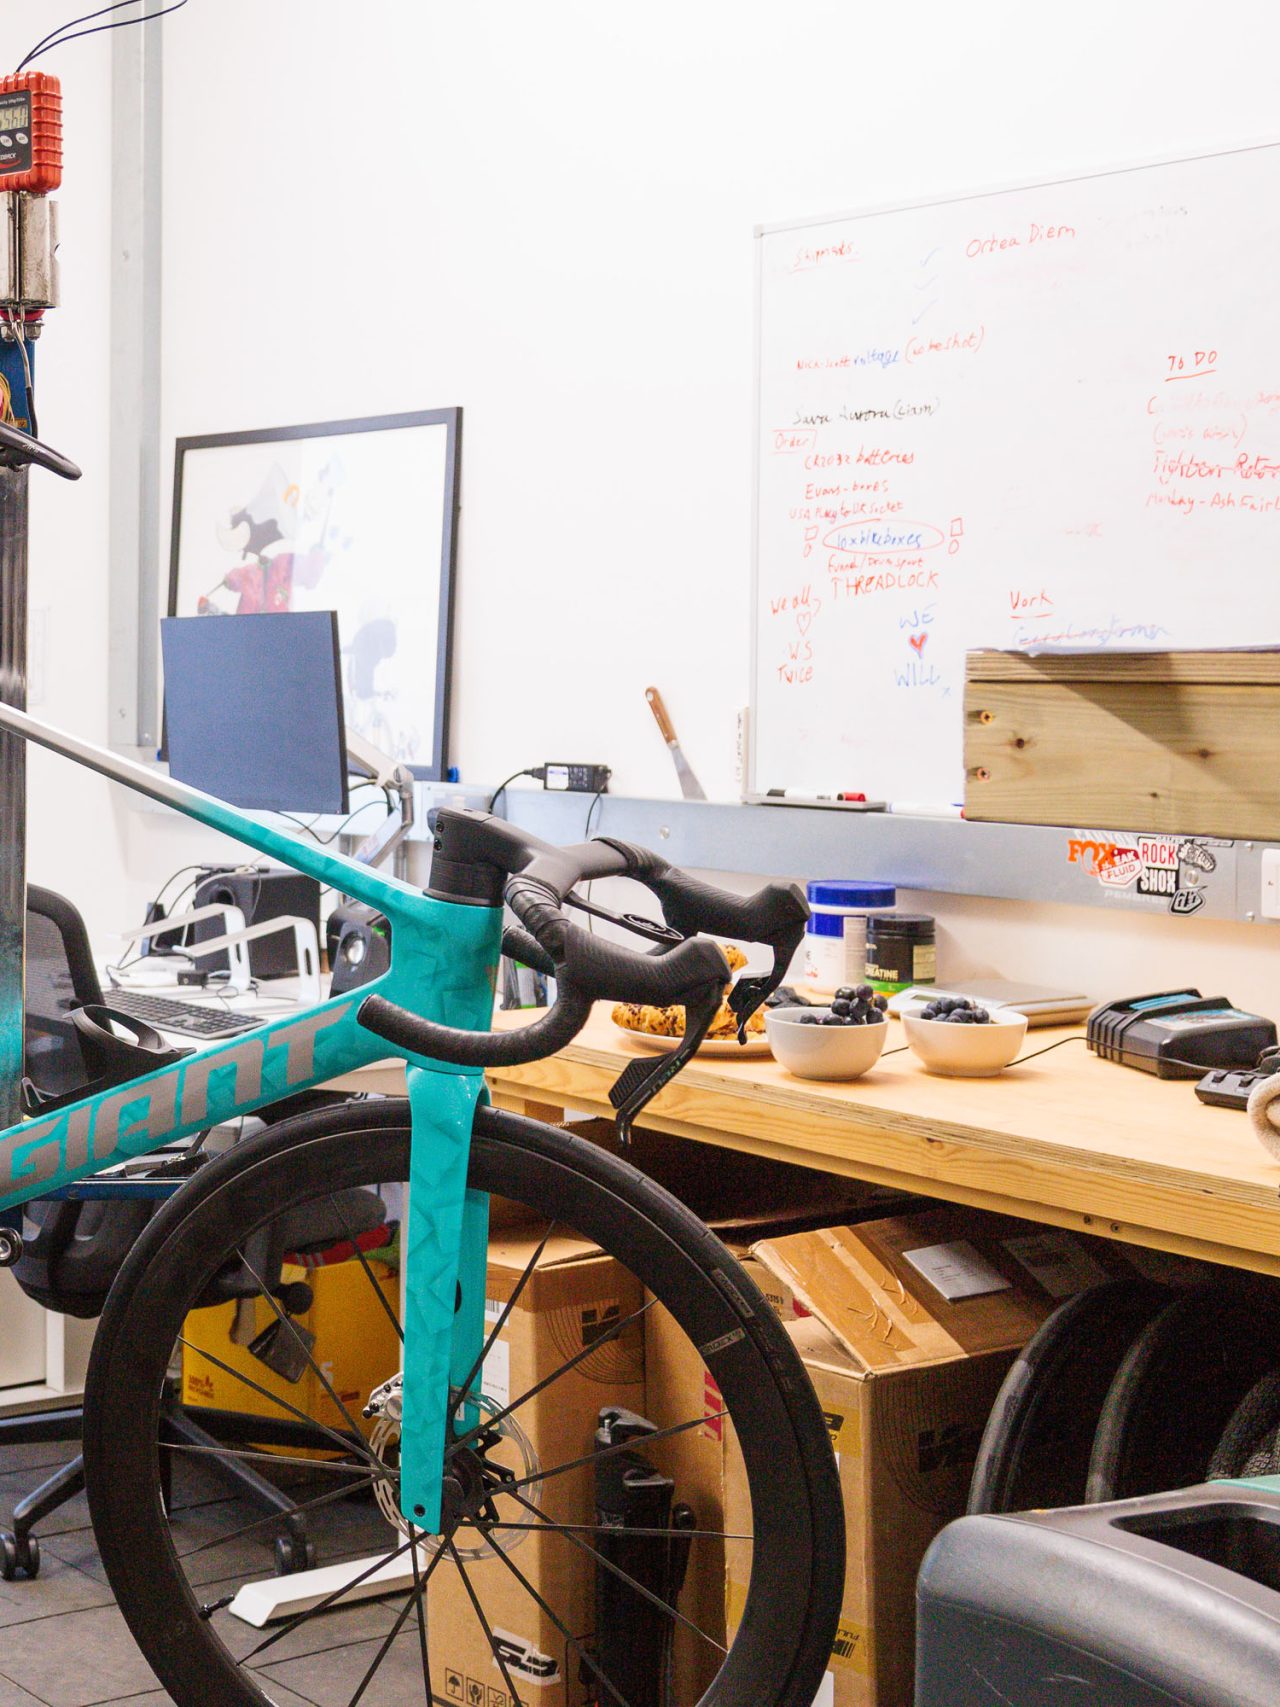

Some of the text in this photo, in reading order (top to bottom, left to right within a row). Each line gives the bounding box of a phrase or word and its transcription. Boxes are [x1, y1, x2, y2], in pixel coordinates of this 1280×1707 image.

[1068, 839, 1117, 864] FOX
[1141, 842, 1176, 866] ROCK
[1107, 865, 1136, 879] FLUID
[1140, 868, 1177, 894] SHOX
